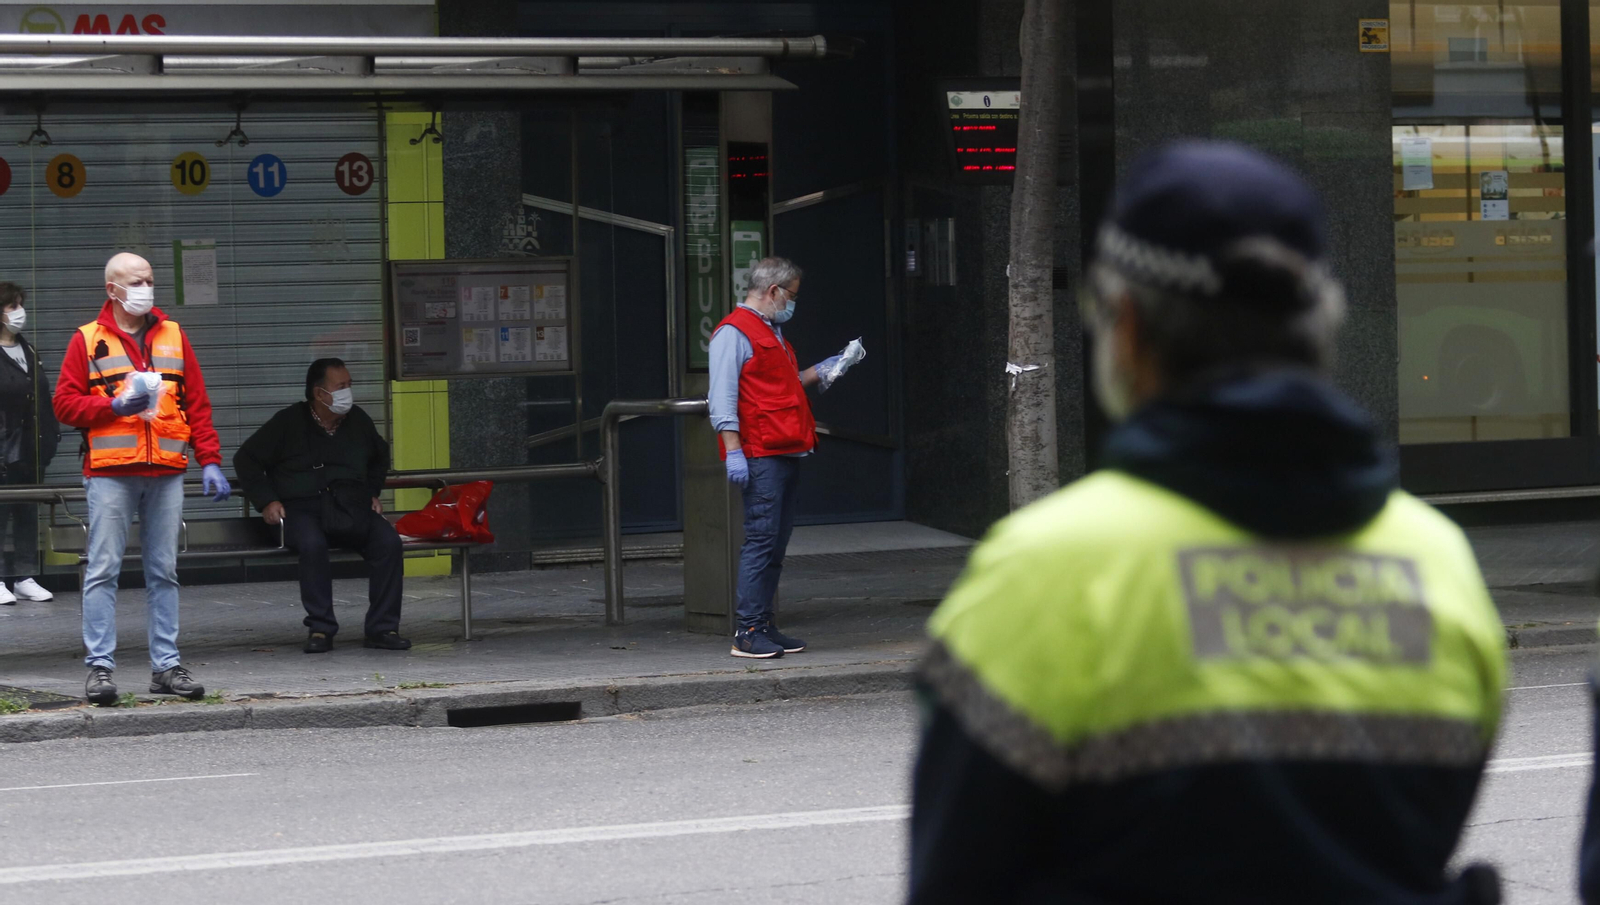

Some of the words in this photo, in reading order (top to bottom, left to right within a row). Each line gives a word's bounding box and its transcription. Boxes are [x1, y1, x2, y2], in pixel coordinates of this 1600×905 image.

[57, 161, 76, 190] 8
[175, 160, 206, 186] 10
[252, 162, 280, 188] 11
[338, 161, 369, 187] 13
[1221, 604, 1401, 659] LOCAL
